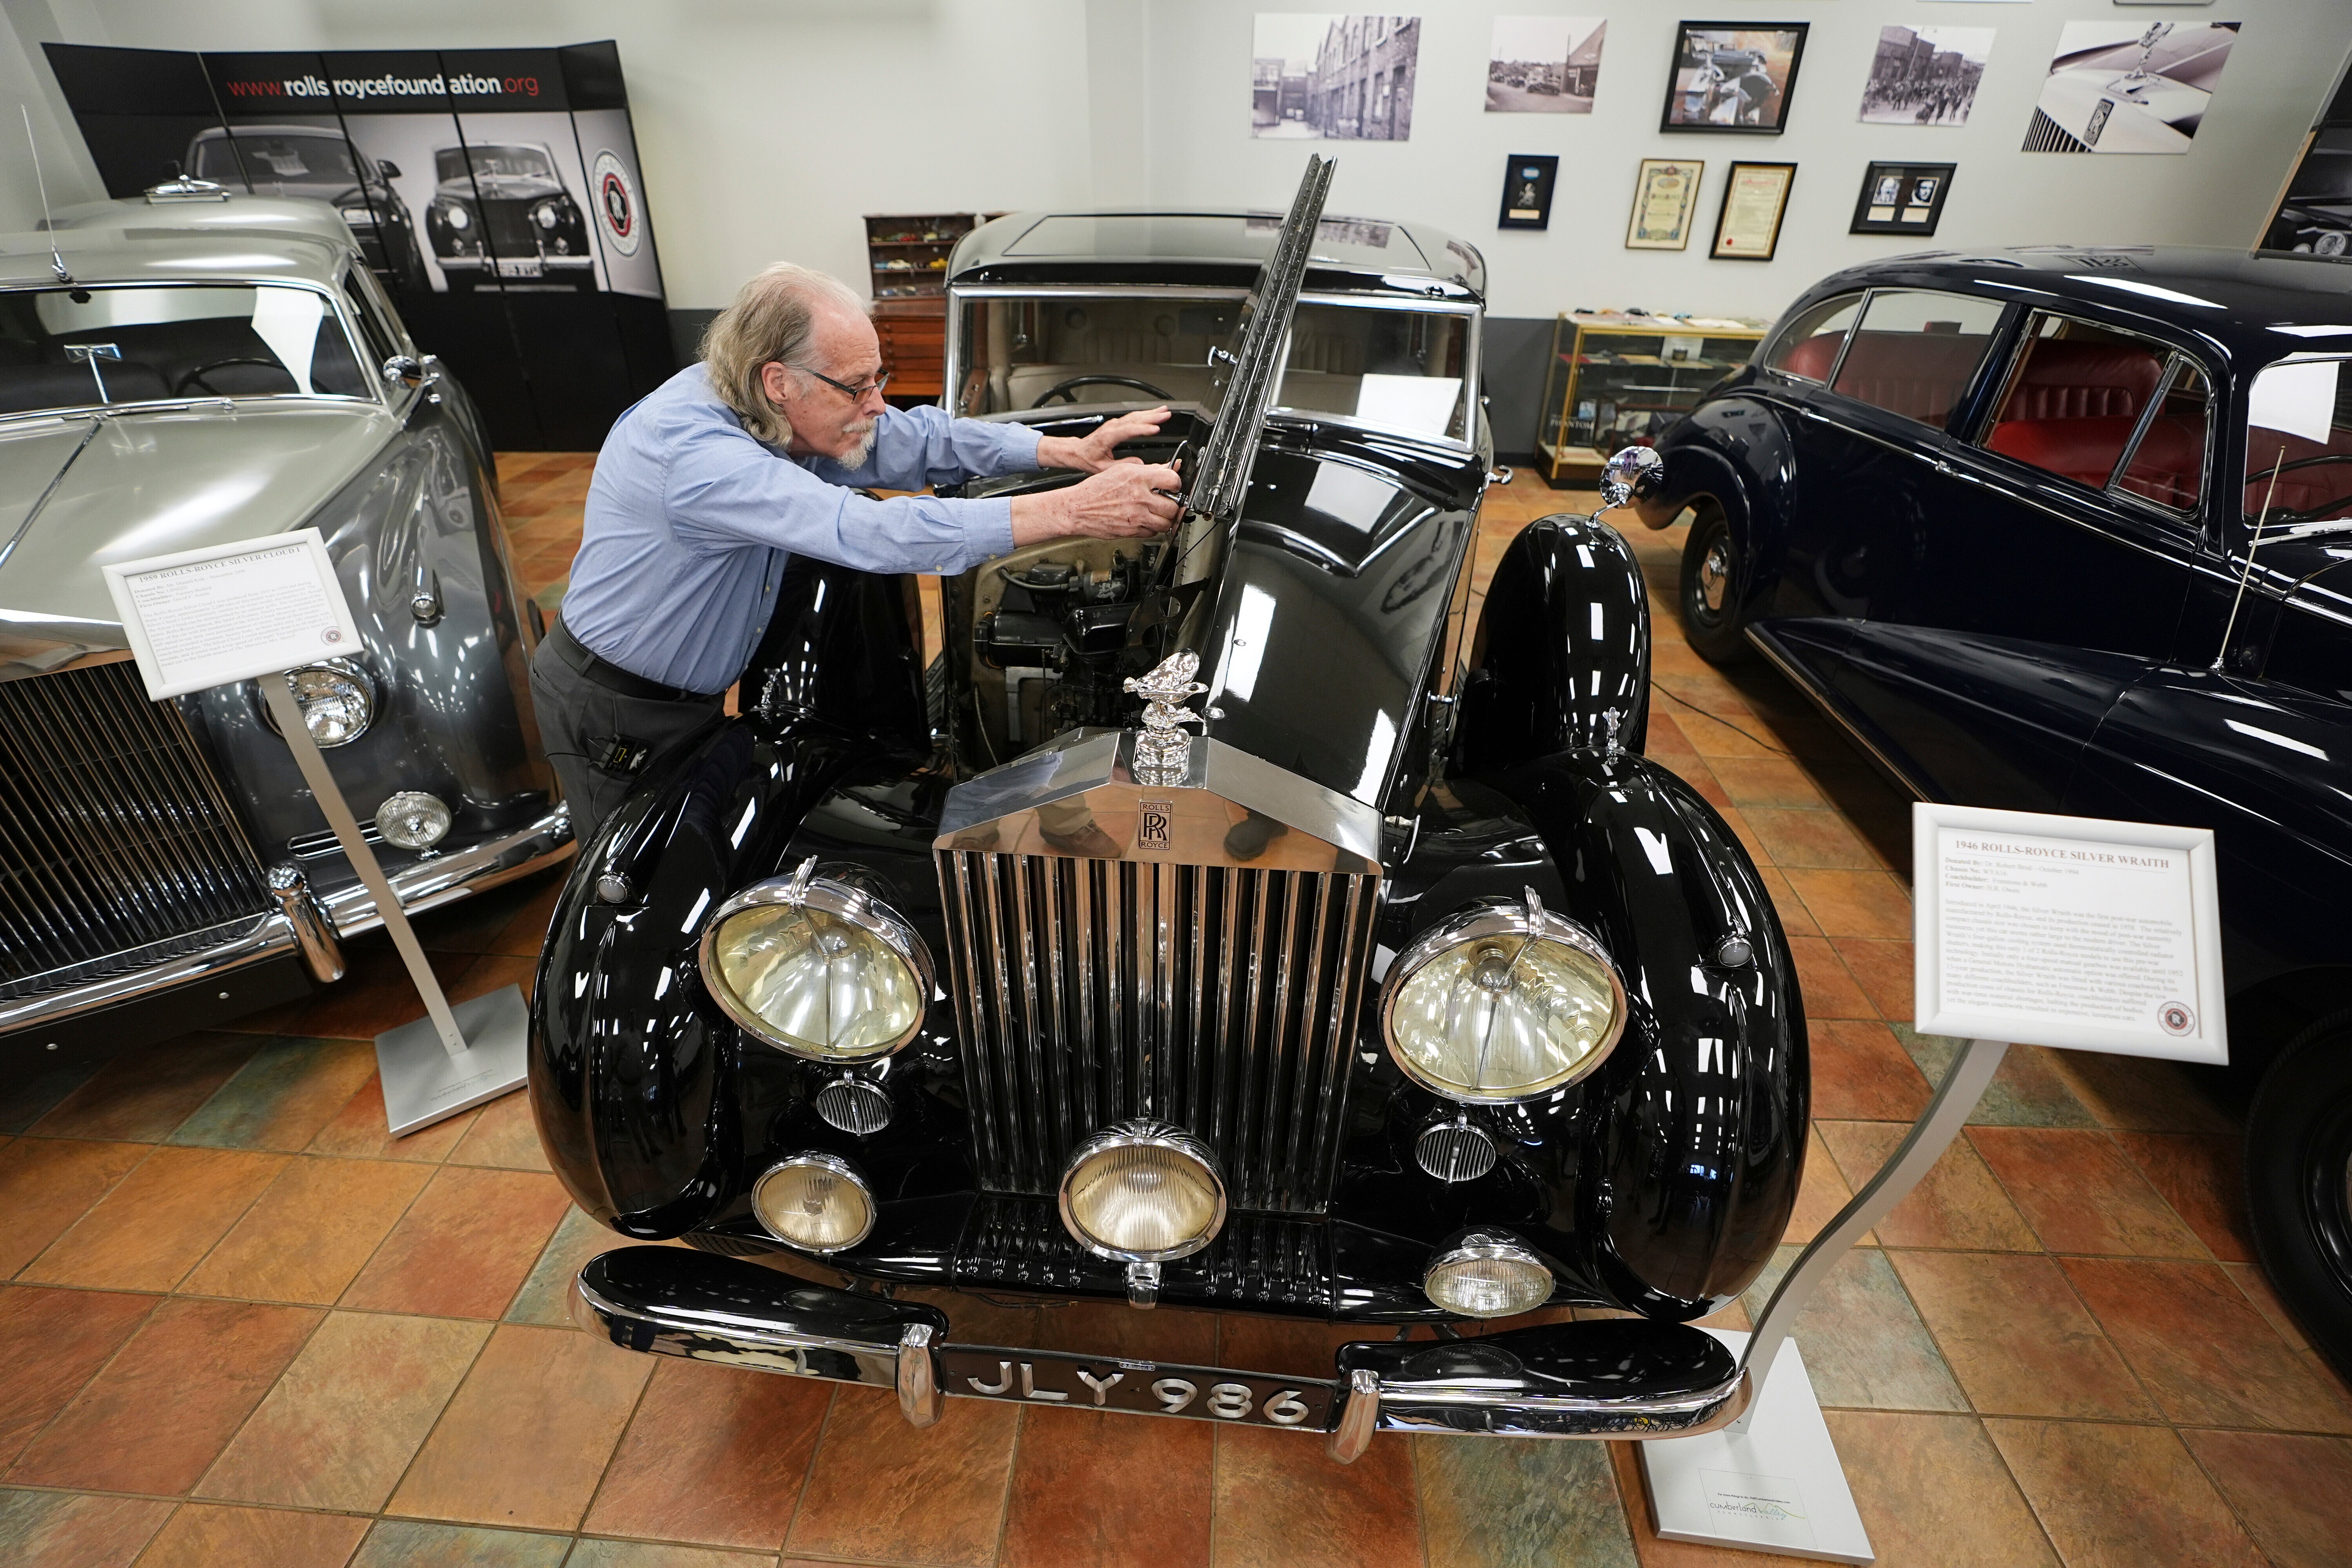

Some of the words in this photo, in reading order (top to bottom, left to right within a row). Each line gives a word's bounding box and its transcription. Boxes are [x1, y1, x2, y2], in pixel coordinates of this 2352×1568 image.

[139, 574, 158, 582] 1959
[159, 561, 227, 578] ROLLS-ROYCE
[228, 555, 262, 565] SILVER
[263, 548, 295, 559] CLOUD
[1956, 840, 1978, 850] 1946
[1981, 842, 2066, 858] ROLLS-ROYCE
[2070, 851, 2114, 863] SILVER
[2118, 855, 2169, 868] WRAITH
[967, 1361, 1124, 1406] JLY
[1151, 1378, 1309, 1425] 986
